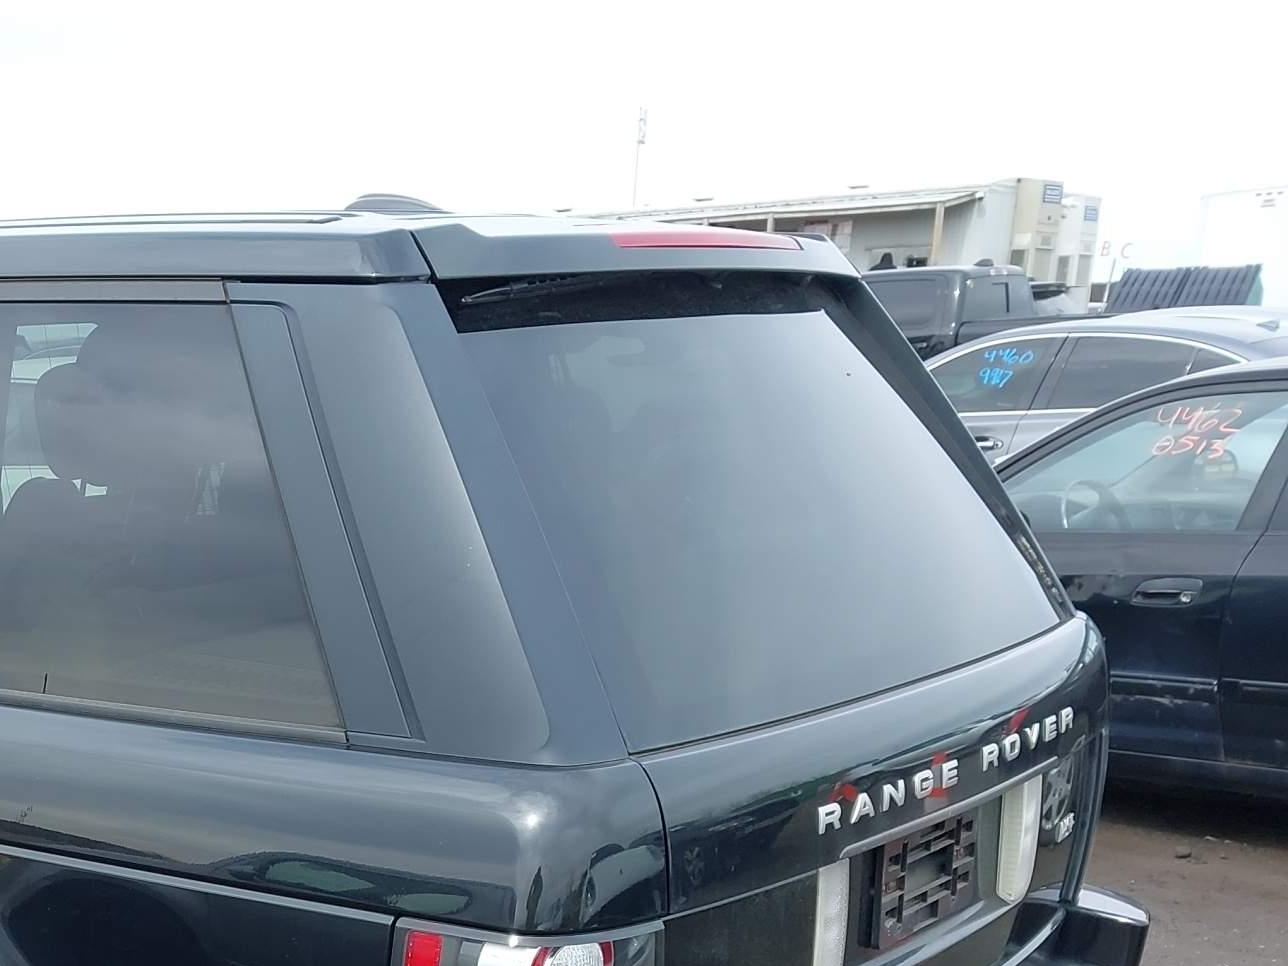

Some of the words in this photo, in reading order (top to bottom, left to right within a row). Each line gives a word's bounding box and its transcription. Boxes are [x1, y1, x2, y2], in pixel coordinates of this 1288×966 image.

[984, 348, 1034, 366] 4460
[1158, 402, 1243, 433] 4462
[817, 758, 960, 836] RANGE
[981, 705, 1075, 773] ROVER
